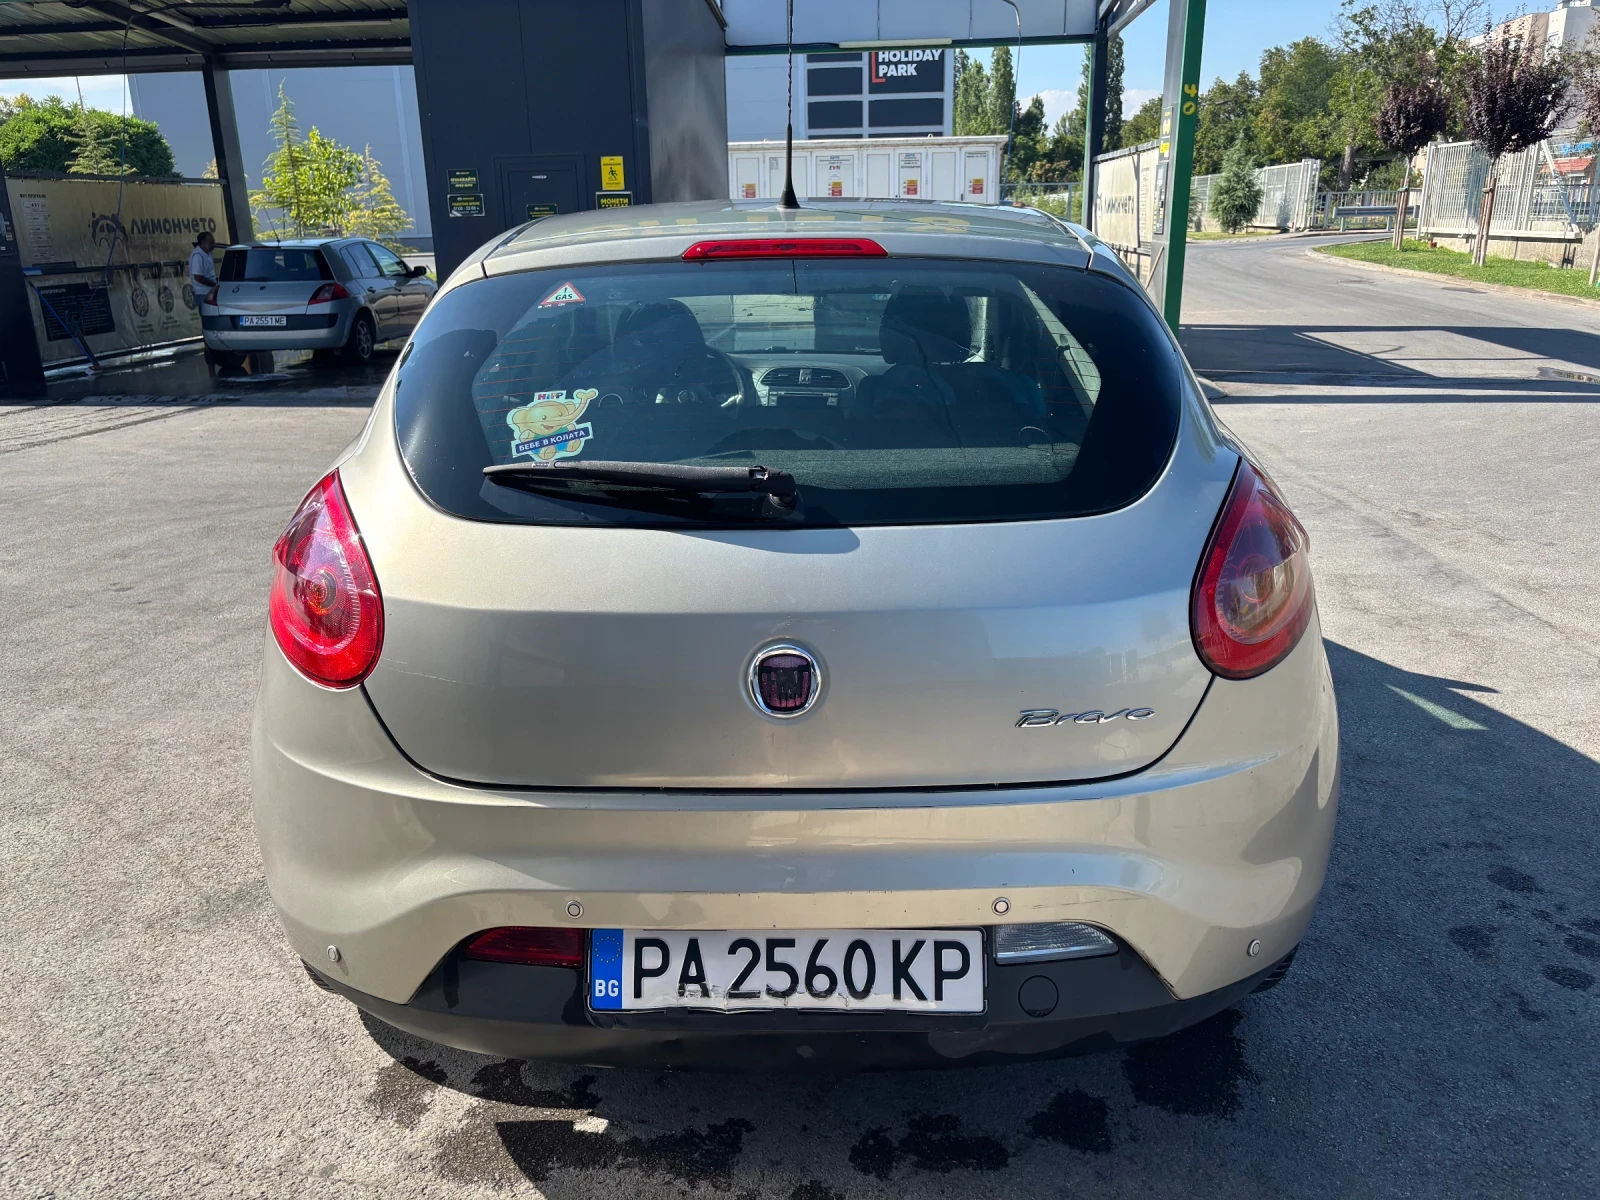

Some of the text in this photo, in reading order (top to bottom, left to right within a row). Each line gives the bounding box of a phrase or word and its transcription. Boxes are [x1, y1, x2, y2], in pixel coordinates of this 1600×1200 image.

[878, 48, 943, 62] HOLIDAY
[878, 63, 918, 77] PARK
[555, 293, 573, 301] GAS
[244, 316, 285, 325] PA 2551 ME
[519, 429, 586, 452] БЕБЕ В КОЛАТА
[1015, 708, 1155, 728] Bravo
[633, 938, 971, 1002] PA 2560 KP
[595, 979, 619, 998] BG
